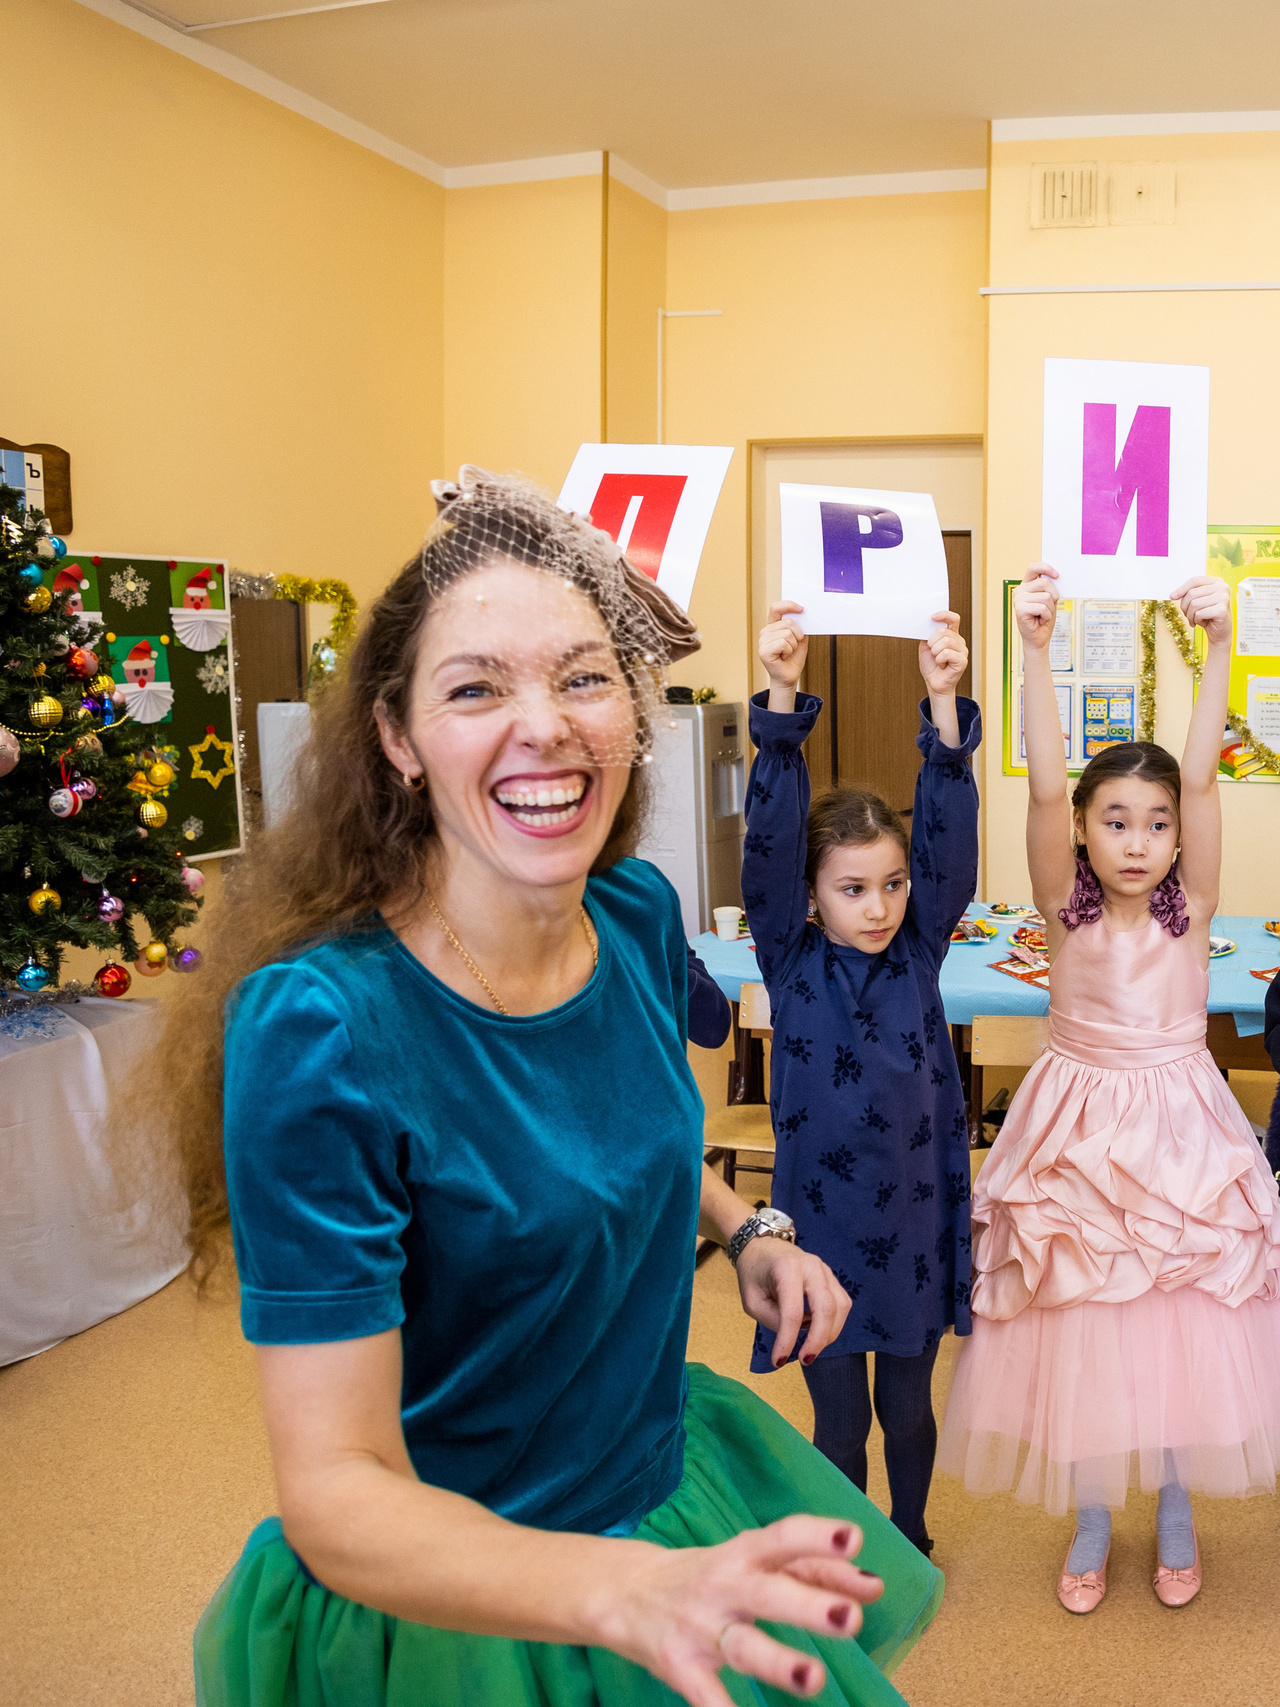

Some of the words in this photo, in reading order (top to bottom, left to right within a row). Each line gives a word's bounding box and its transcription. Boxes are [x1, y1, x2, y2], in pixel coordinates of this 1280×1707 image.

[589, 473, 689, 583] П
[1081, 402, 1171, 557] И
[819, 501, 904, 595] Р
